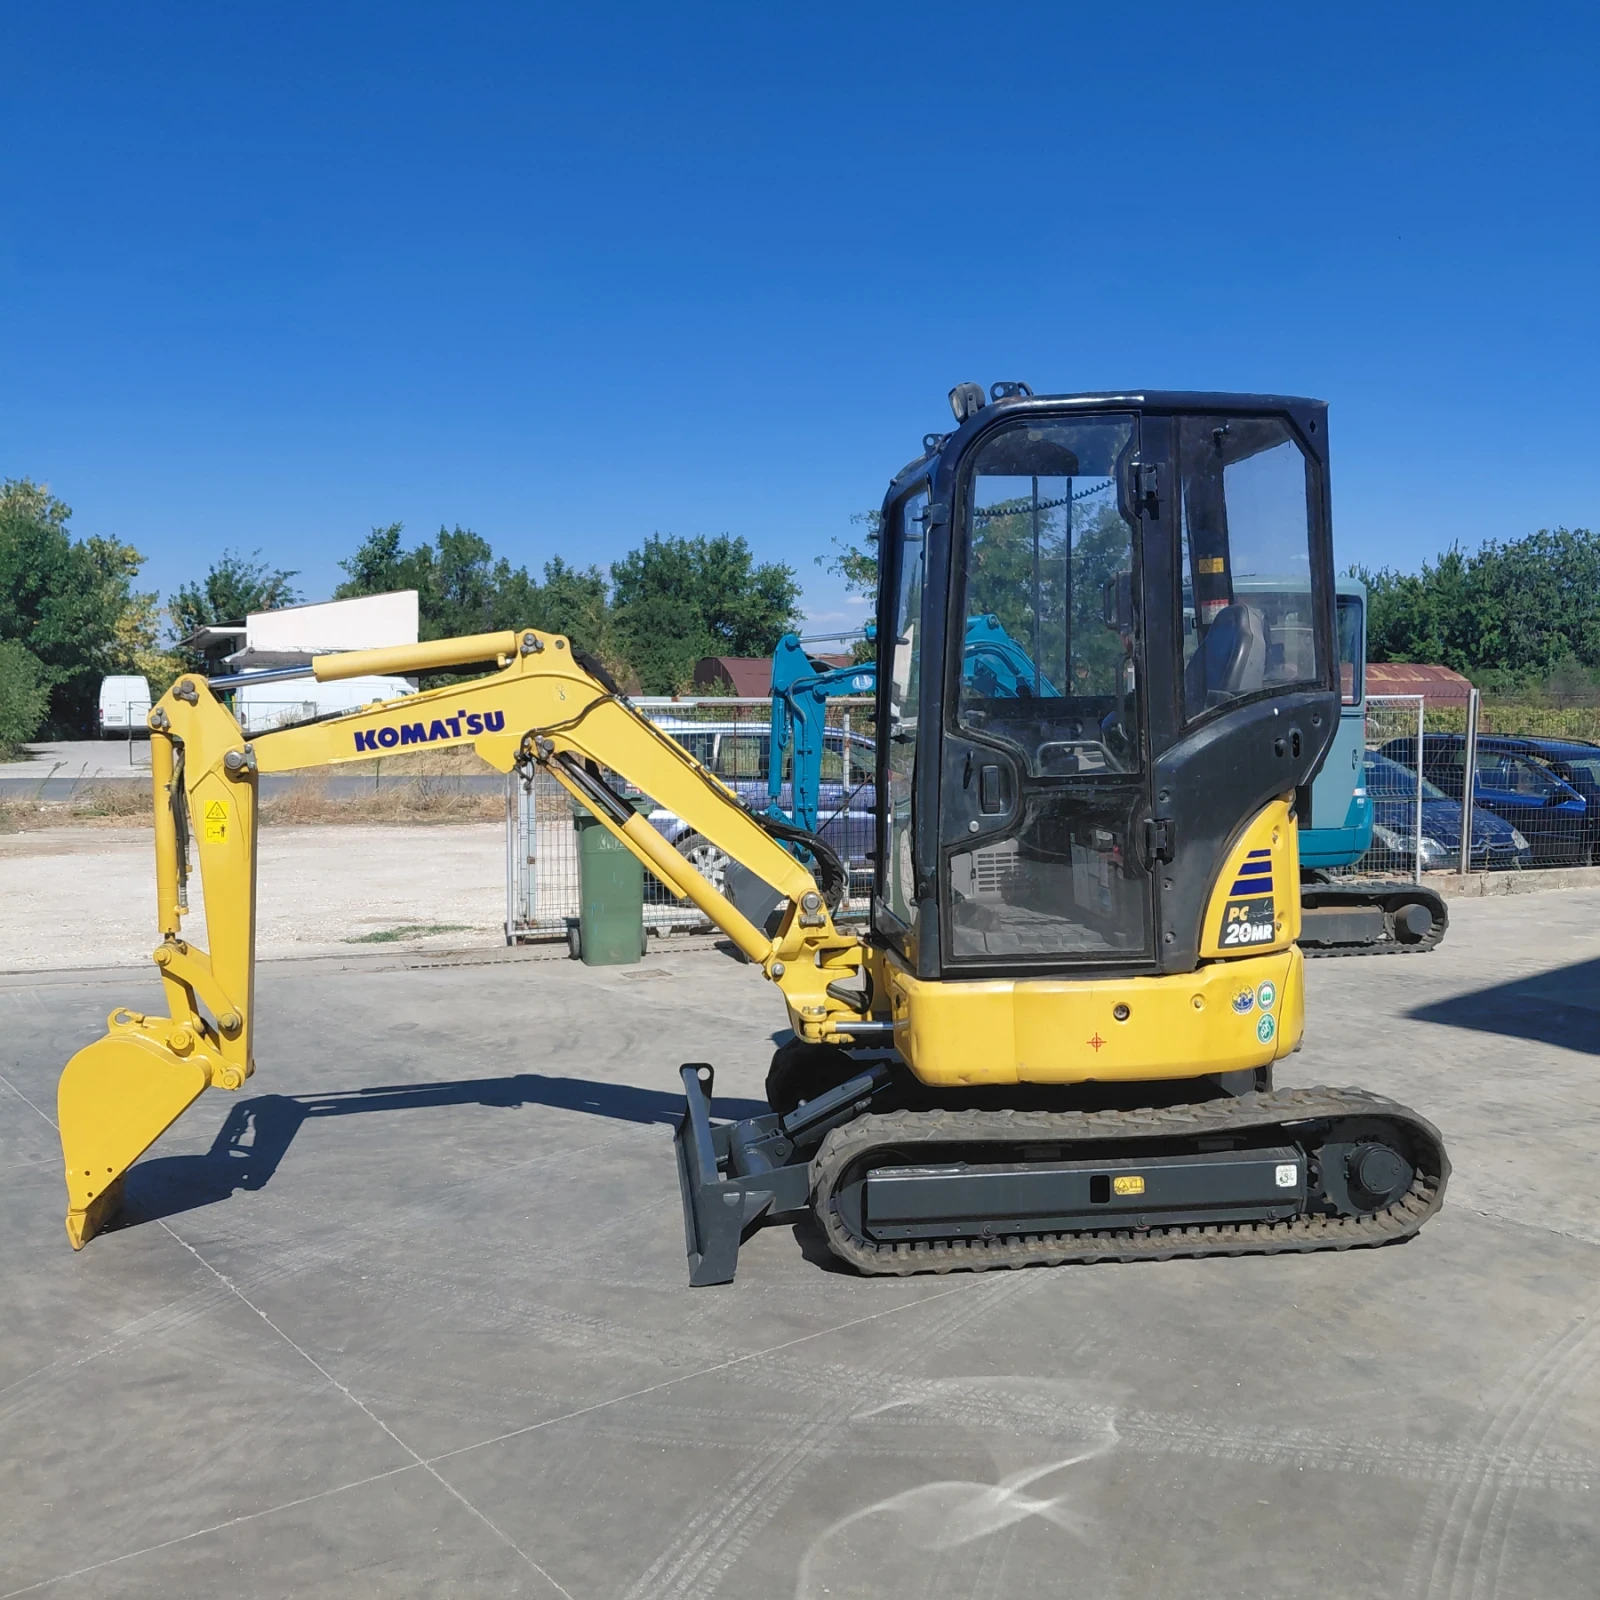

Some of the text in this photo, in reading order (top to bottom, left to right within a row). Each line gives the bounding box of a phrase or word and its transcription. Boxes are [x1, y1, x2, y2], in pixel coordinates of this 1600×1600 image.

[354, 709, 505, 752] KOMATSU
[1228, 906, 1249, 923] PC
[1224, 922, 1273, 944] 20MR
